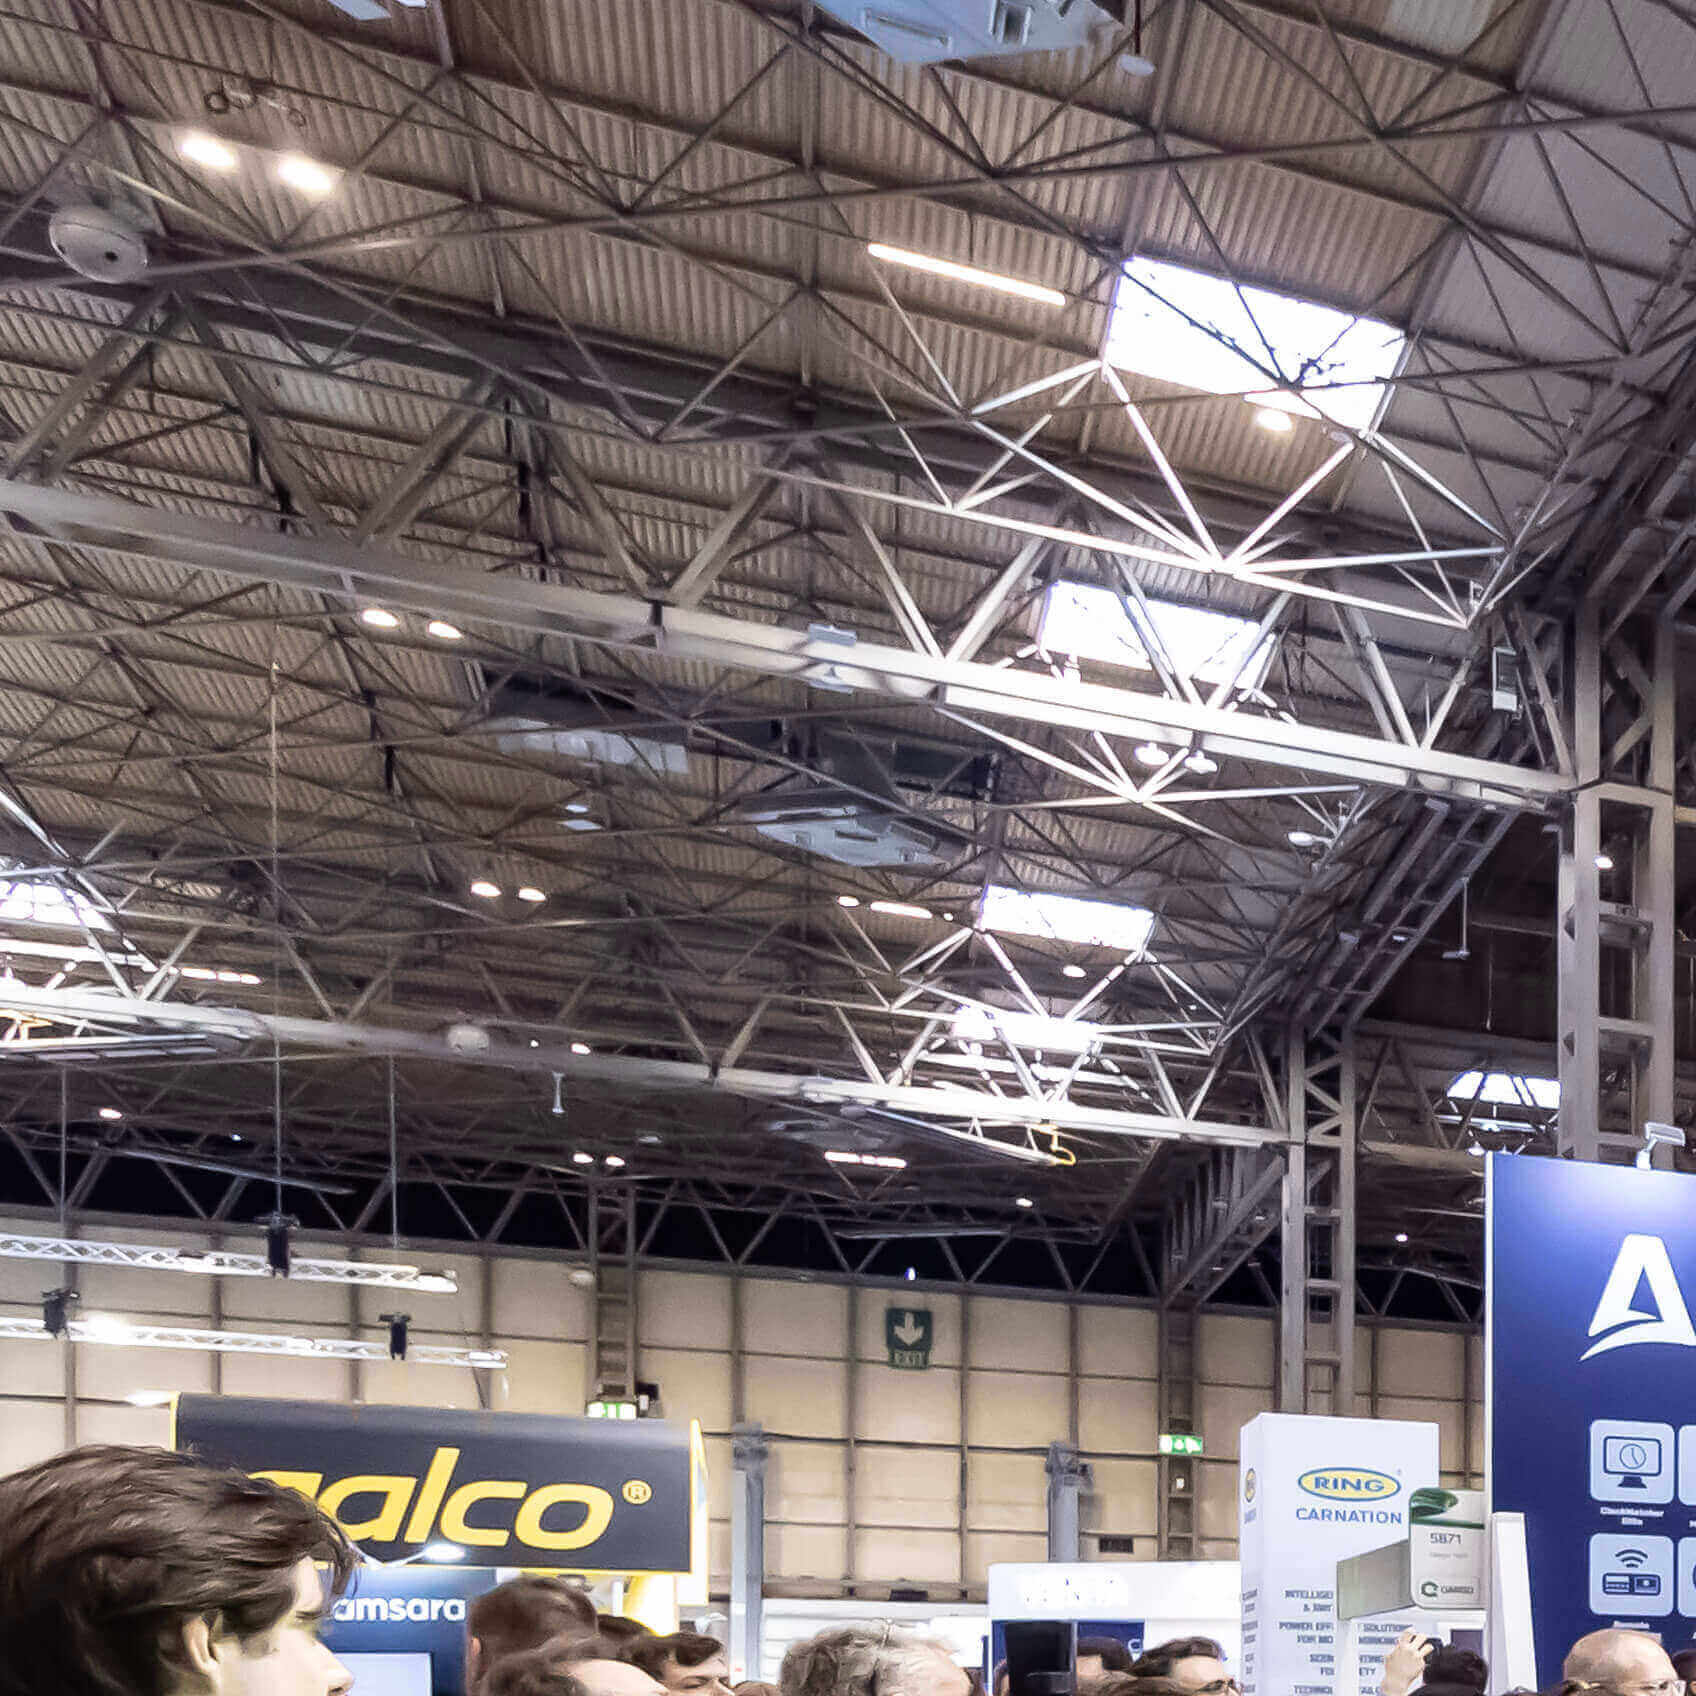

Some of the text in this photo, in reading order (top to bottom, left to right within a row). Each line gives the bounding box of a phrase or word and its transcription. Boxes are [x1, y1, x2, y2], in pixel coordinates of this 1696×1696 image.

[1313, 1476, 1385, 1493] RING
[1295, 1507, 1402, 1524] CARNATION
[333, 1597, 466, 1622] amsara
